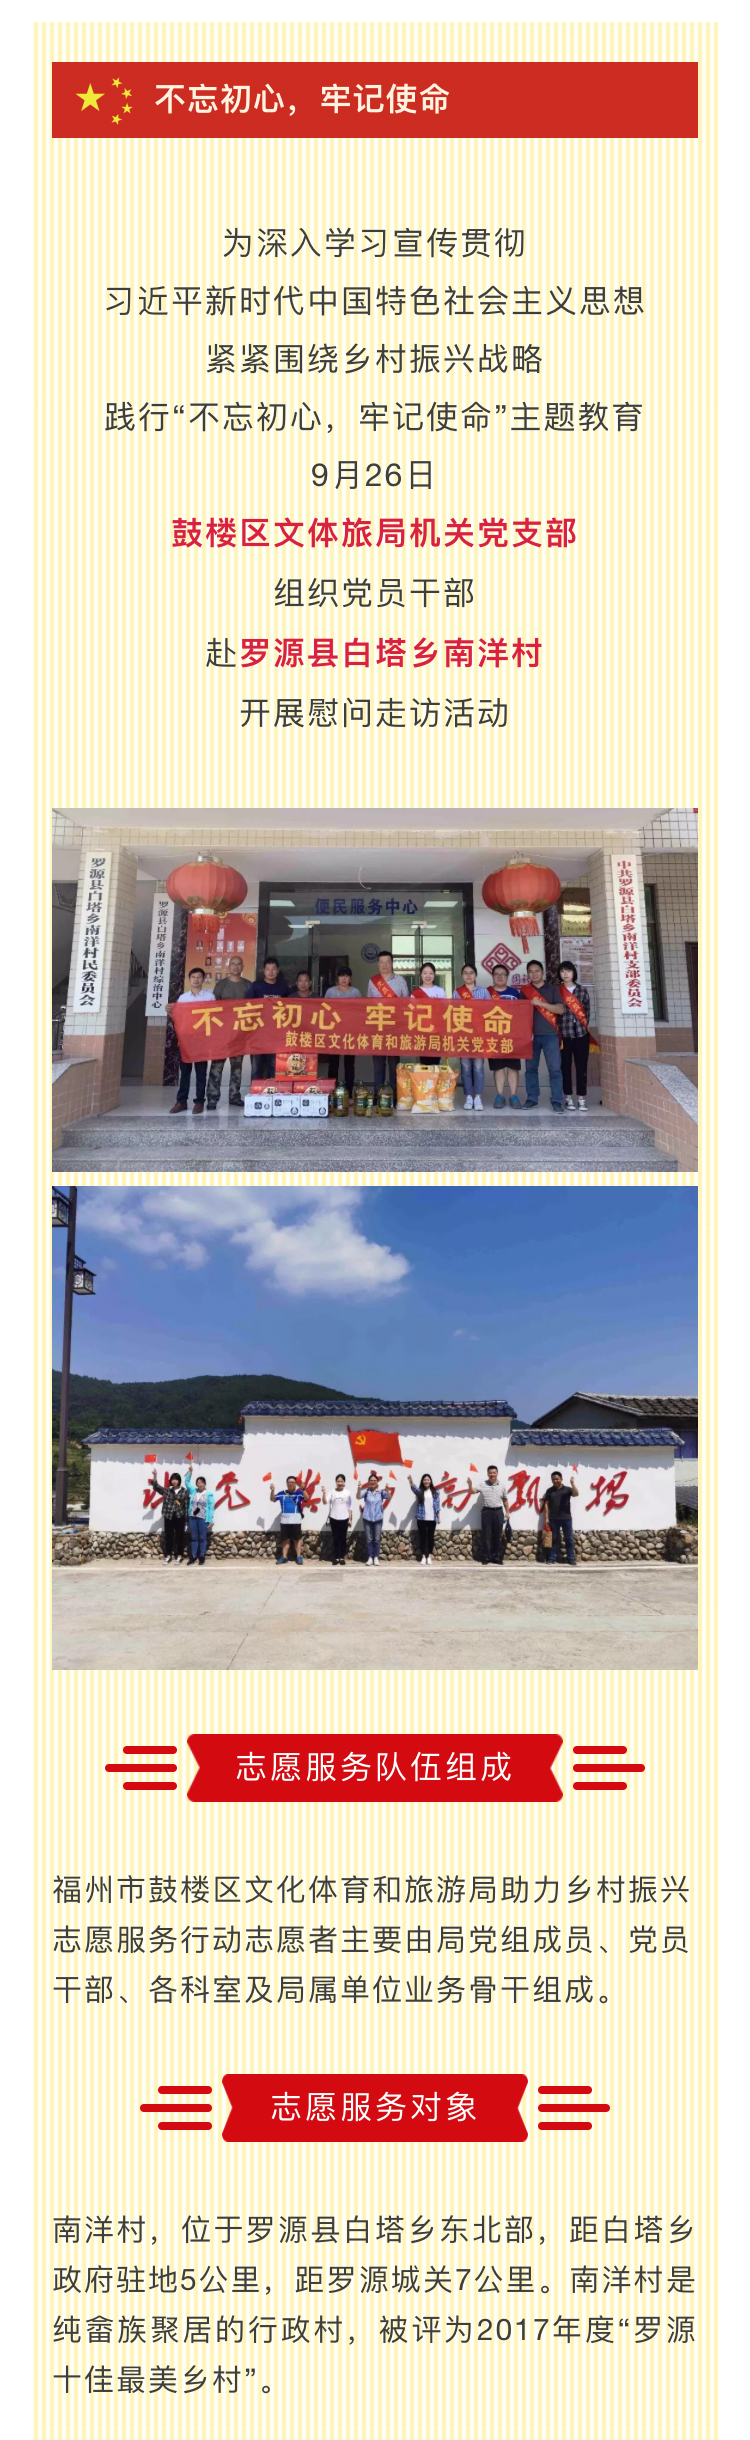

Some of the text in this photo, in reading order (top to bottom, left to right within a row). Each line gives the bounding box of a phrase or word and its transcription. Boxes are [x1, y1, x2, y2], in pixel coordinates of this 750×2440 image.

[79, 857, 106, 1006] 罗源县白塔乡南洋村民委员会
[314, 897, 419, 916] 便民服务中心
[617, 860, 643, 1008] 中共罗源县白塔乡南洋村支部委员会
[151, 900, 169, 1009] 罗源县白塔乡南洋村综治中心
[191, 1001, 342, 1037] 不忘初心
[365, 1002, 514, 1036] 牢记使命
[284, 1030, 515, 1055] 鼓楼区文化体育和旅游局机关党支部
